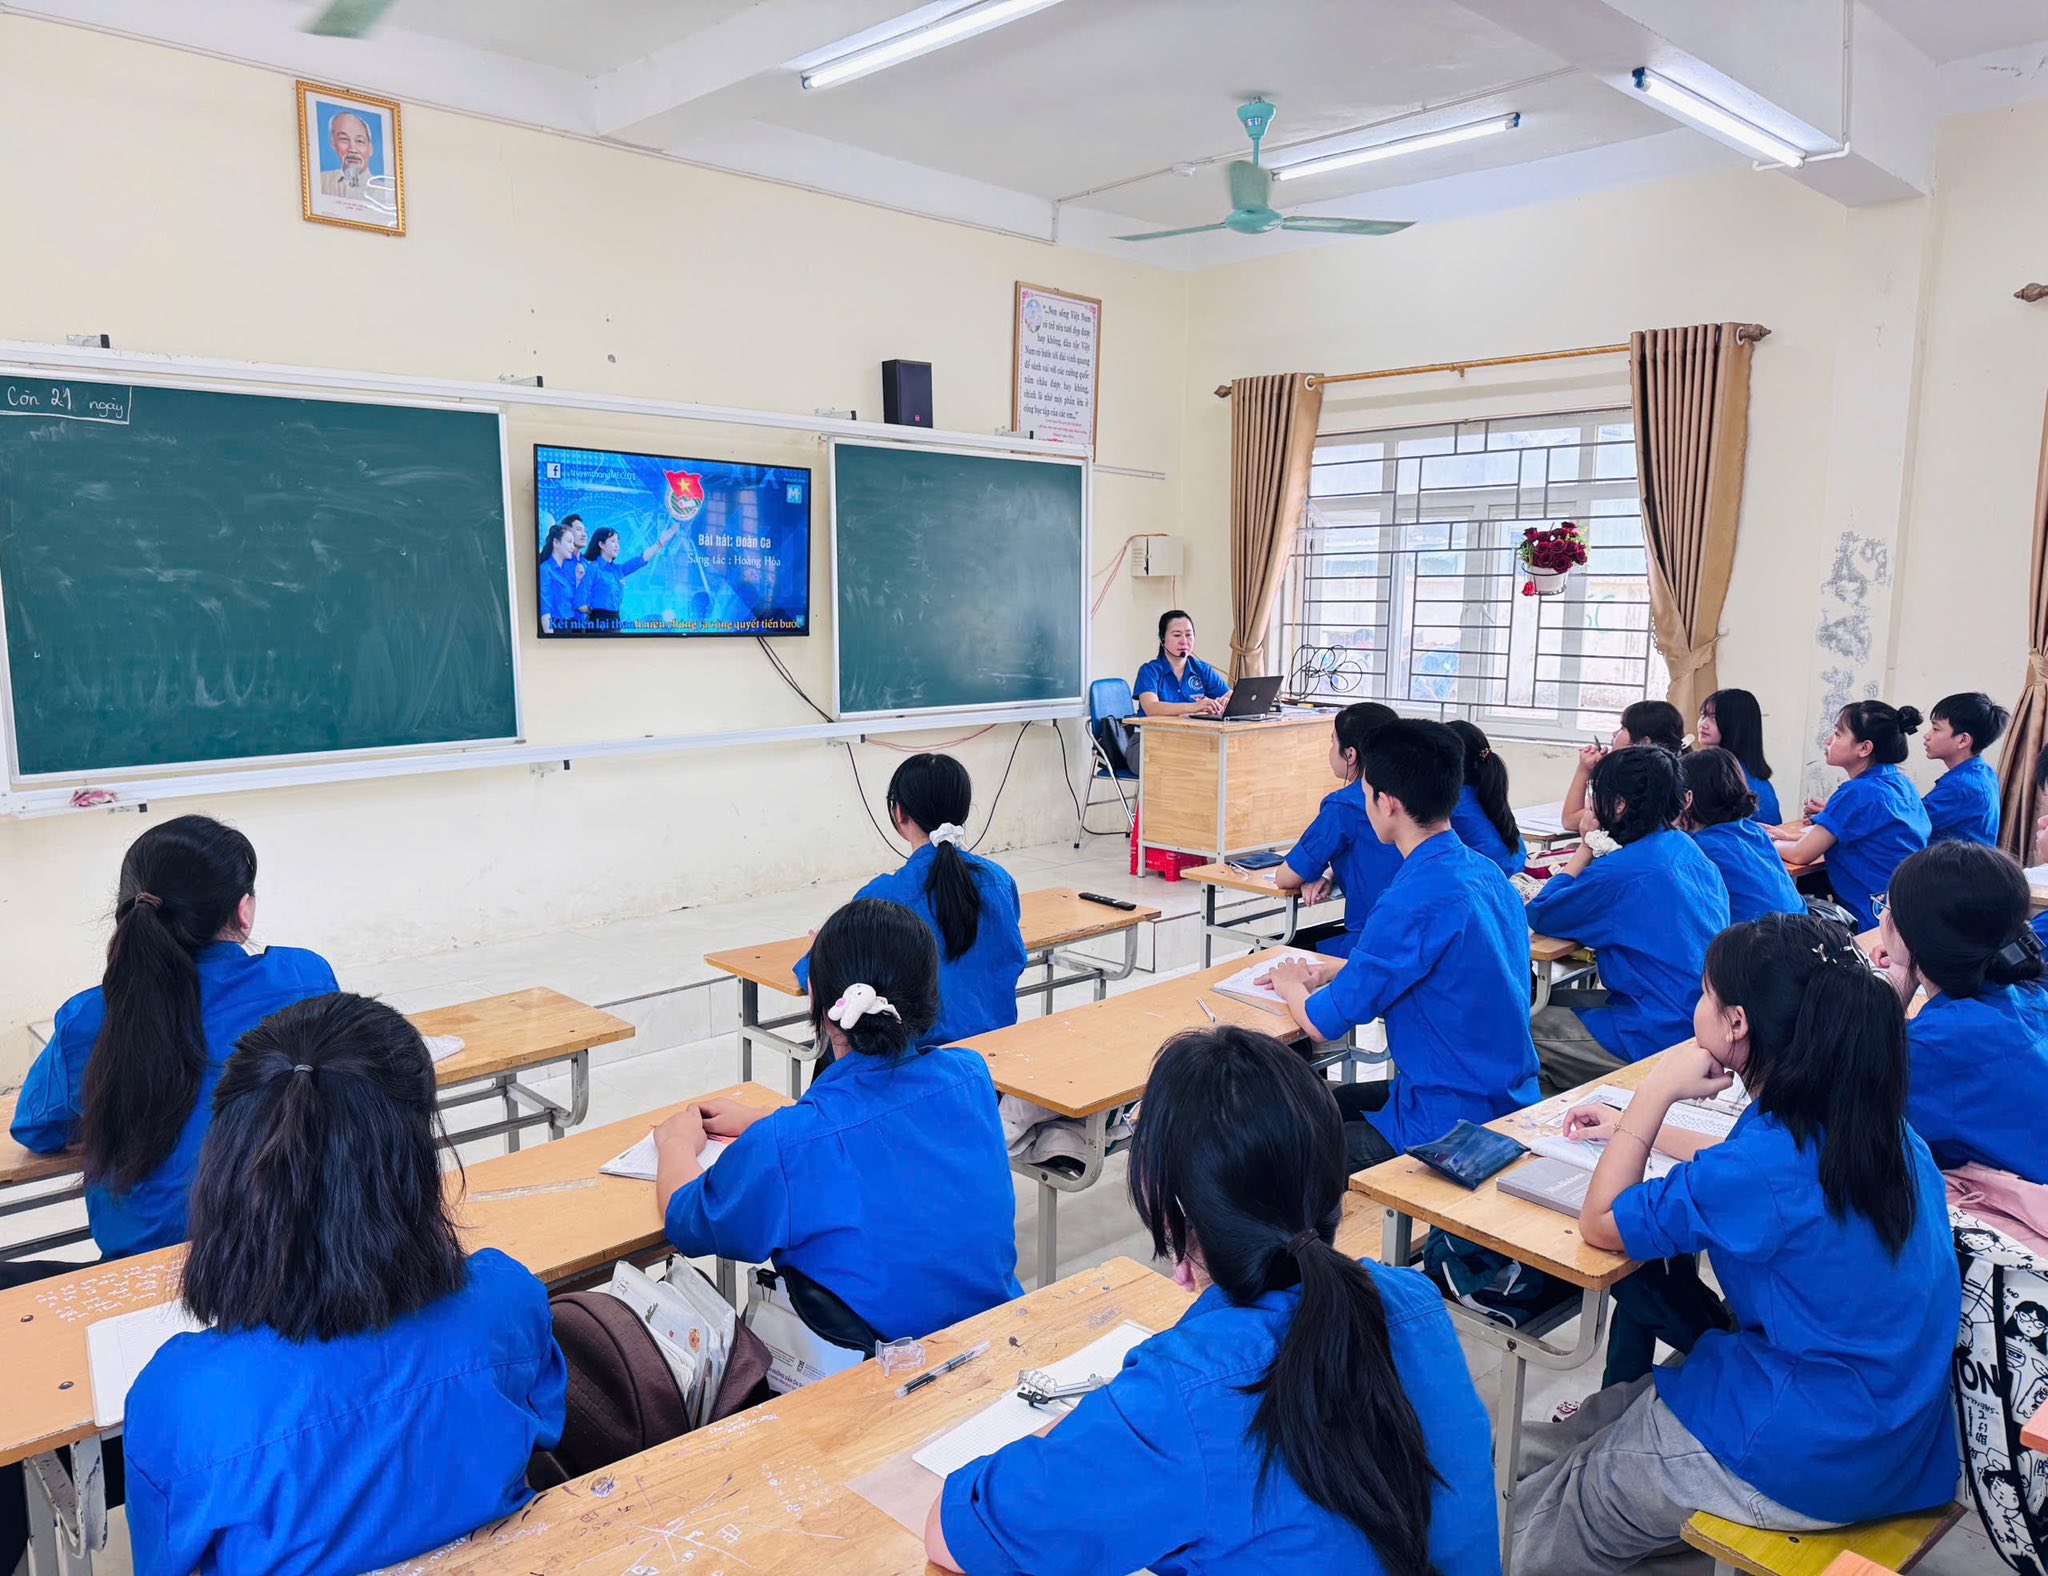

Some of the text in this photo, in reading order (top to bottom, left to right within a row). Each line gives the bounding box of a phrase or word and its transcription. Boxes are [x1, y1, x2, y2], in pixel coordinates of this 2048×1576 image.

[7, 386, 124, 419] Còn 21 ngày
[698, 532, 713, 546] Bài
[760, 537, 771, 549] Ca
[712, 554, 726, 565] tác
[734, 554, 761, 568] Hoàng
[764, 555, 781, 567] Hòa
[596, 617, 607, 632] lại
[734, 617, 760, 631] quyết
[761, 617, 779, 629] tiến
